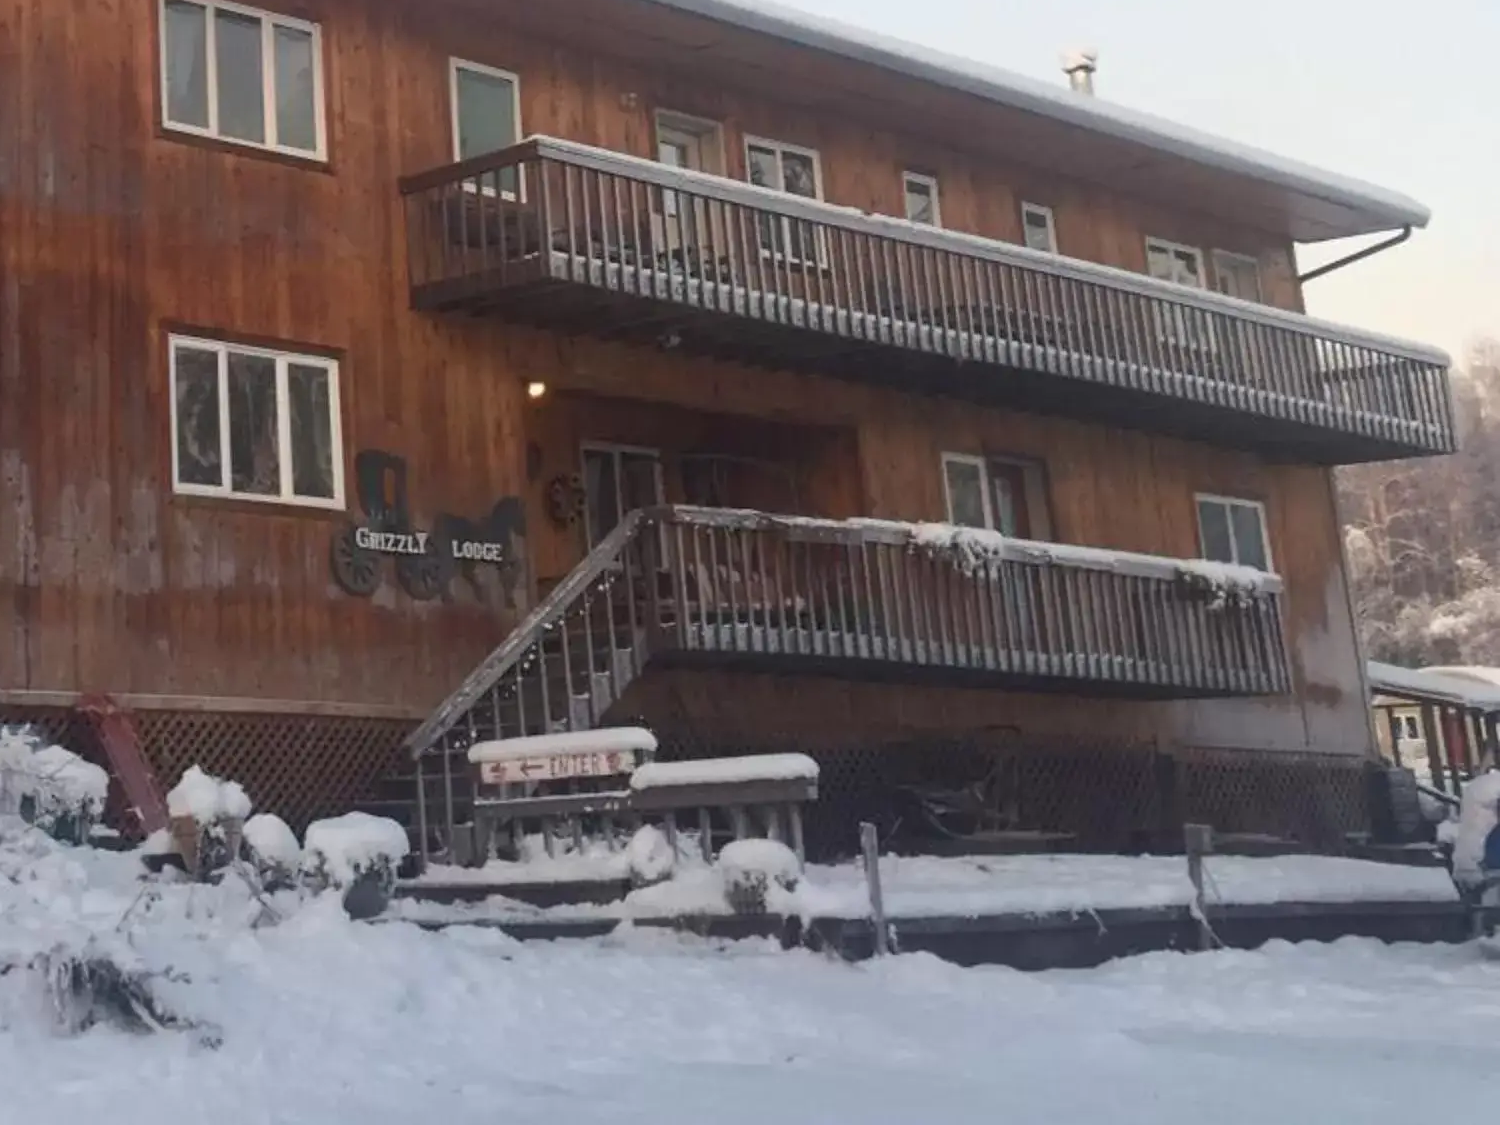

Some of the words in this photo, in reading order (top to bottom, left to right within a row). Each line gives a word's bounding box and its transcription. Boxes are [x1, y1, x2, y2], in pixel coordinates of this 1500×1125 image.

[355, 527, 428, 554] GRIZZLY
[451, 540, 503, 562] LODGE
[549, 752, 599, 776] ENTER
